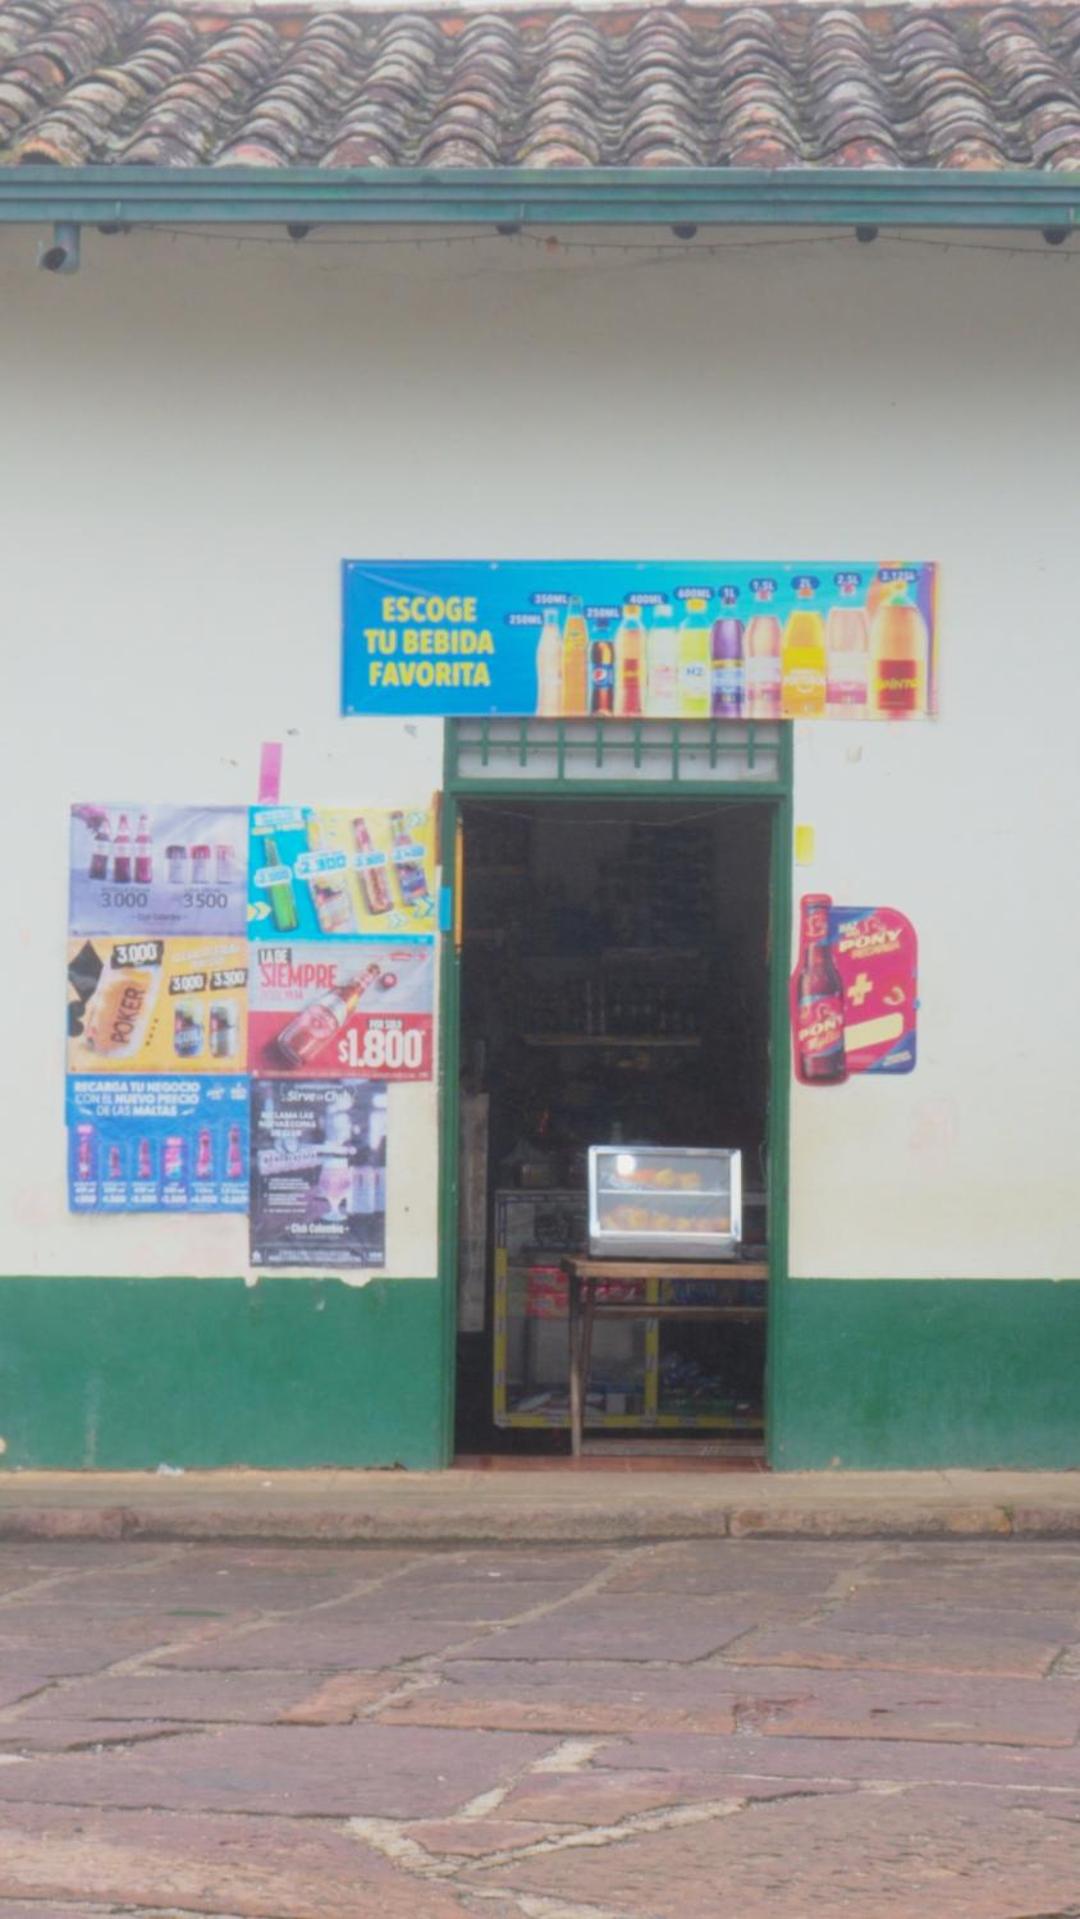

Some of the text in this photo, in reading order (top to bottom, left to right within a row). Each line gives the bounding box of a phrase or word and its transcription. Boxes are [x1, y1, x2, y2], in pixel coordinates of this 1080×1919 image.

[381, 596, 477, 623] ESCOGE
[363, 629, 496, 655] TU BEBIDA
[368, 661, 491, 687] FAVORITA
[838, 928, 903, 953] PONY
[260, 963, 338, 991] SIEMPRE
[110, 986, 146, 1045] POKER
[131, 1081, 145, 1092] TU
[147, 1081, 200, 1092] NEGOCIO
